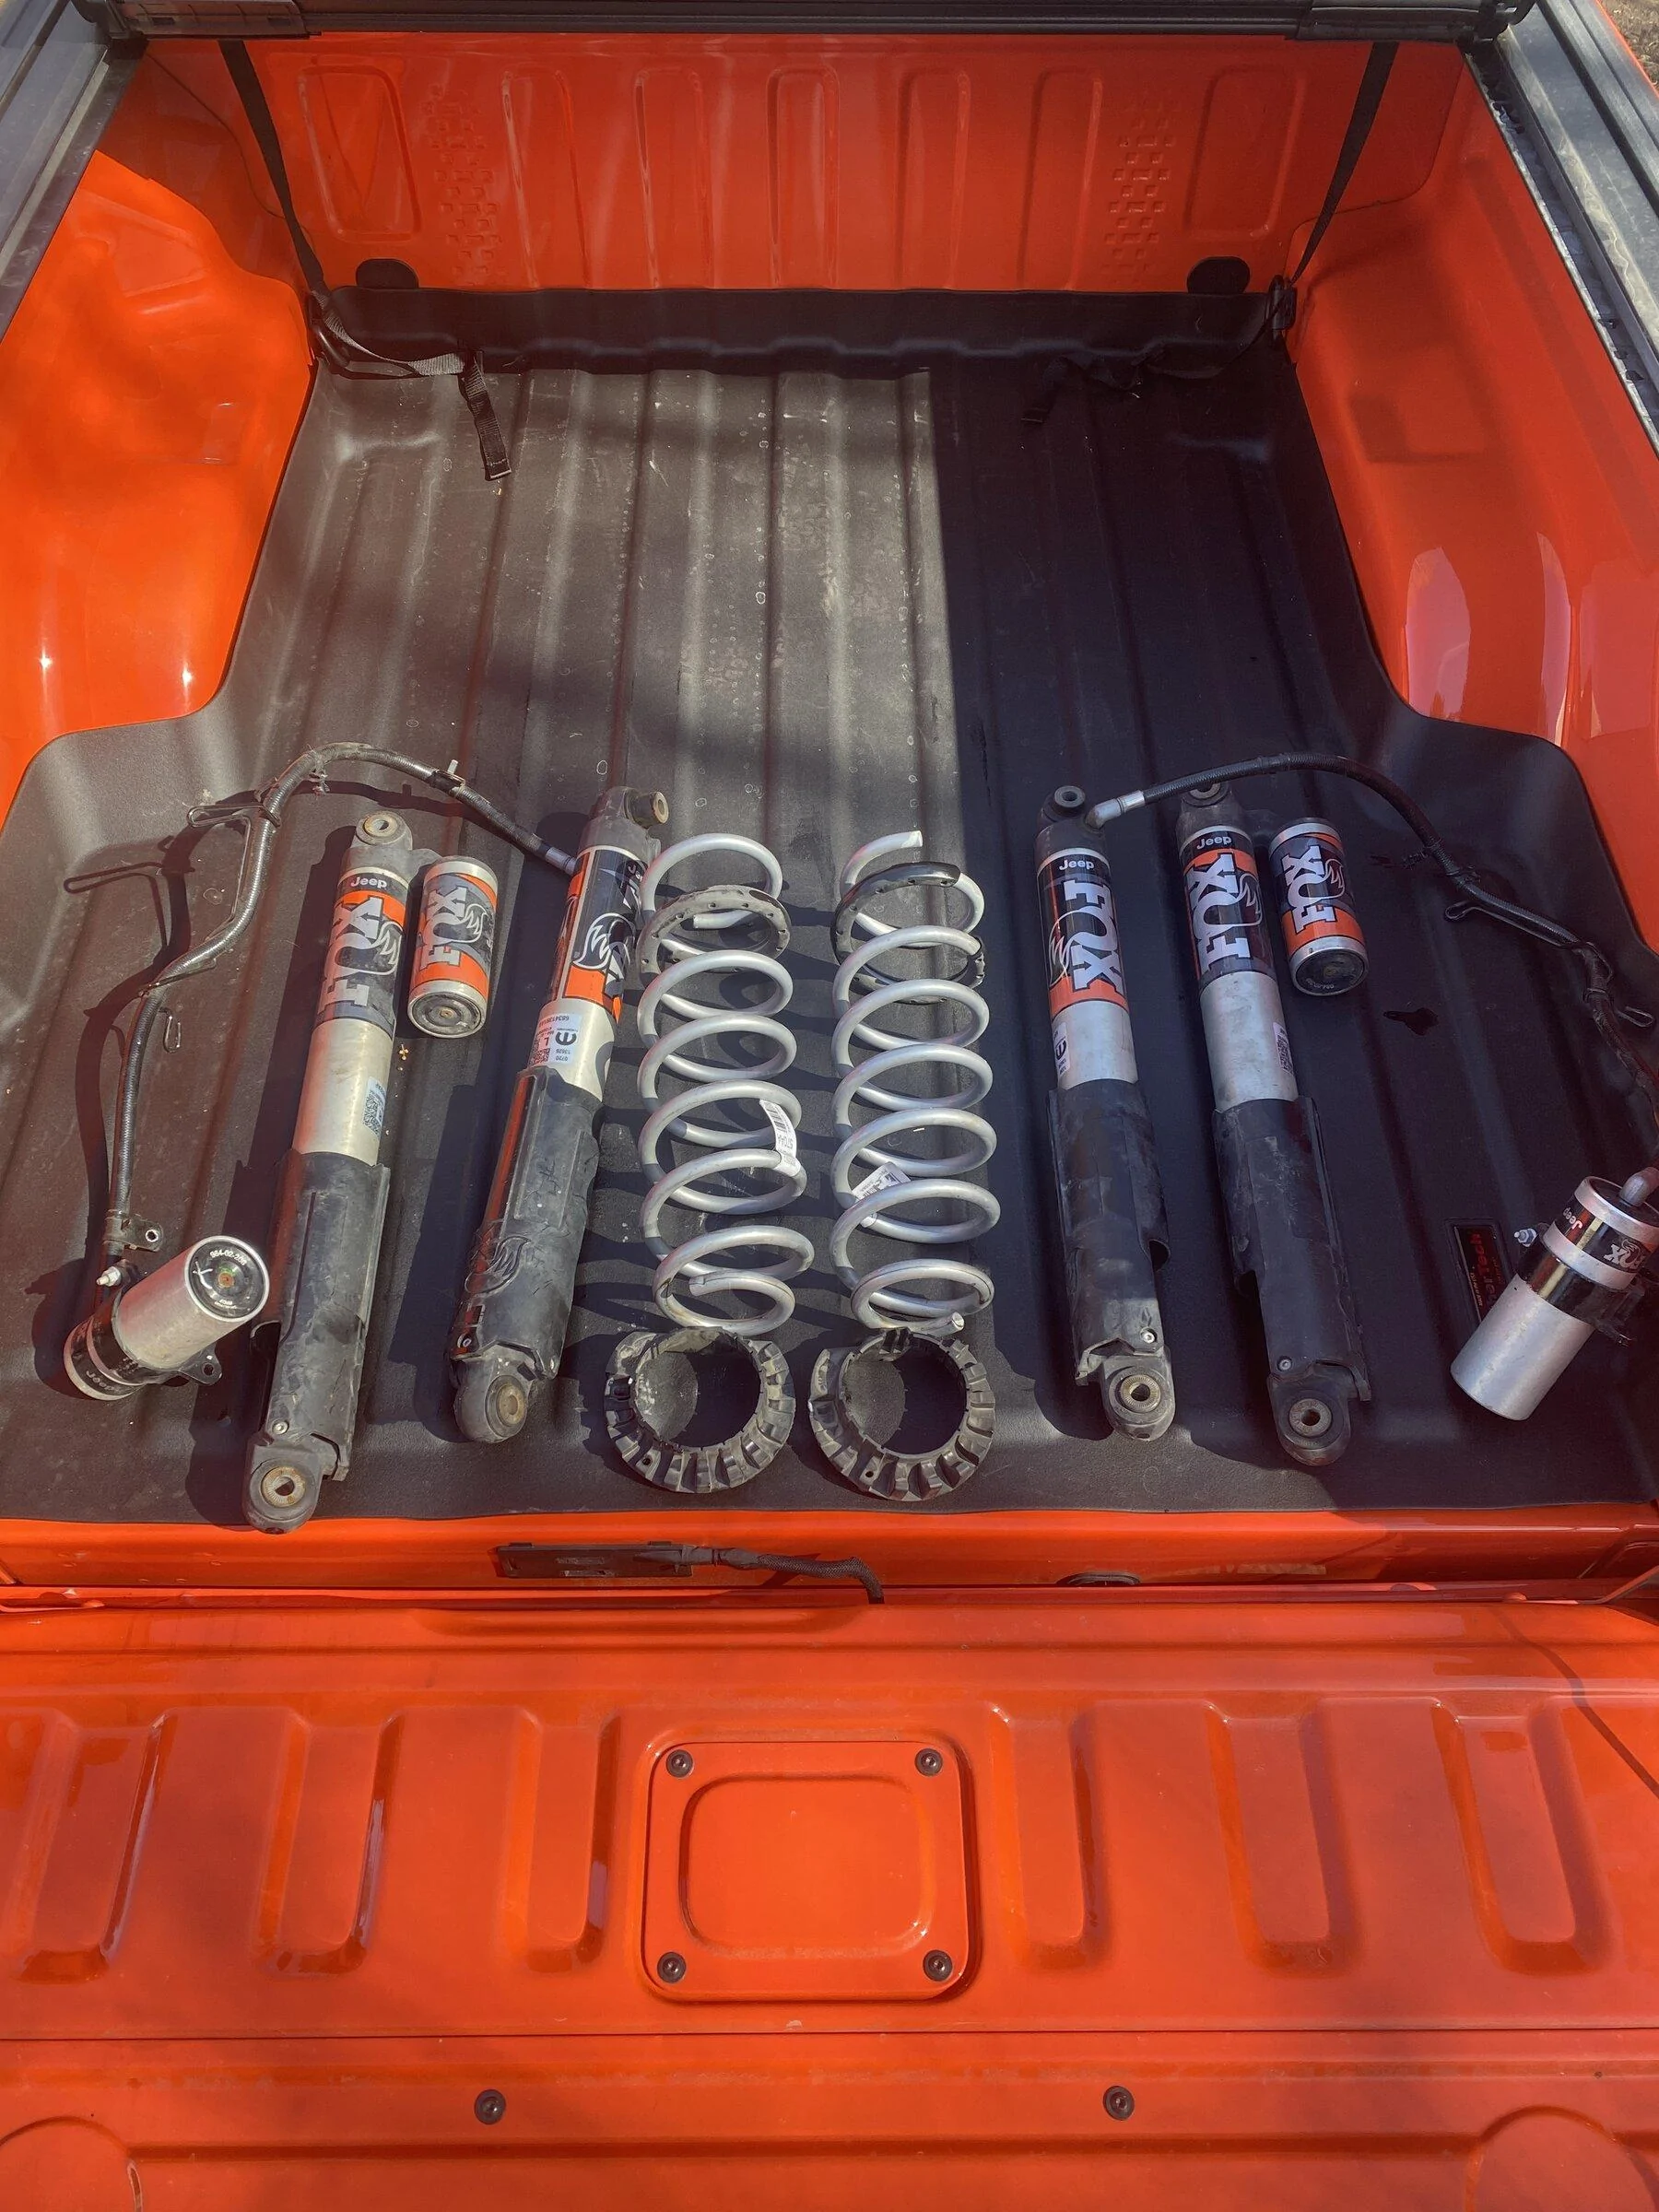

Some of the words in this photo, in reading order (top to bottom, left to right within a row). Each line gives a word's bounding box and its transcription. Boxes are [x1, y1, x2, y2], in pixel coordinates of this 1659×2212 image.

[349, 876, 388, 890] Jeep
[1059, 857, 1095, 872] Jeep
[1196, 834, 1233, 850] Jeep
[419, 886, 488, 971] FOX
[1186, 852, 1262, 975] FOX
[1282, 845, 1346, 935] FOX
[317, 896, 403, 1016] FOX
[1048, 879, 1124, 995] FOX
[1562, 1207, 1583, 1230] Jeep
